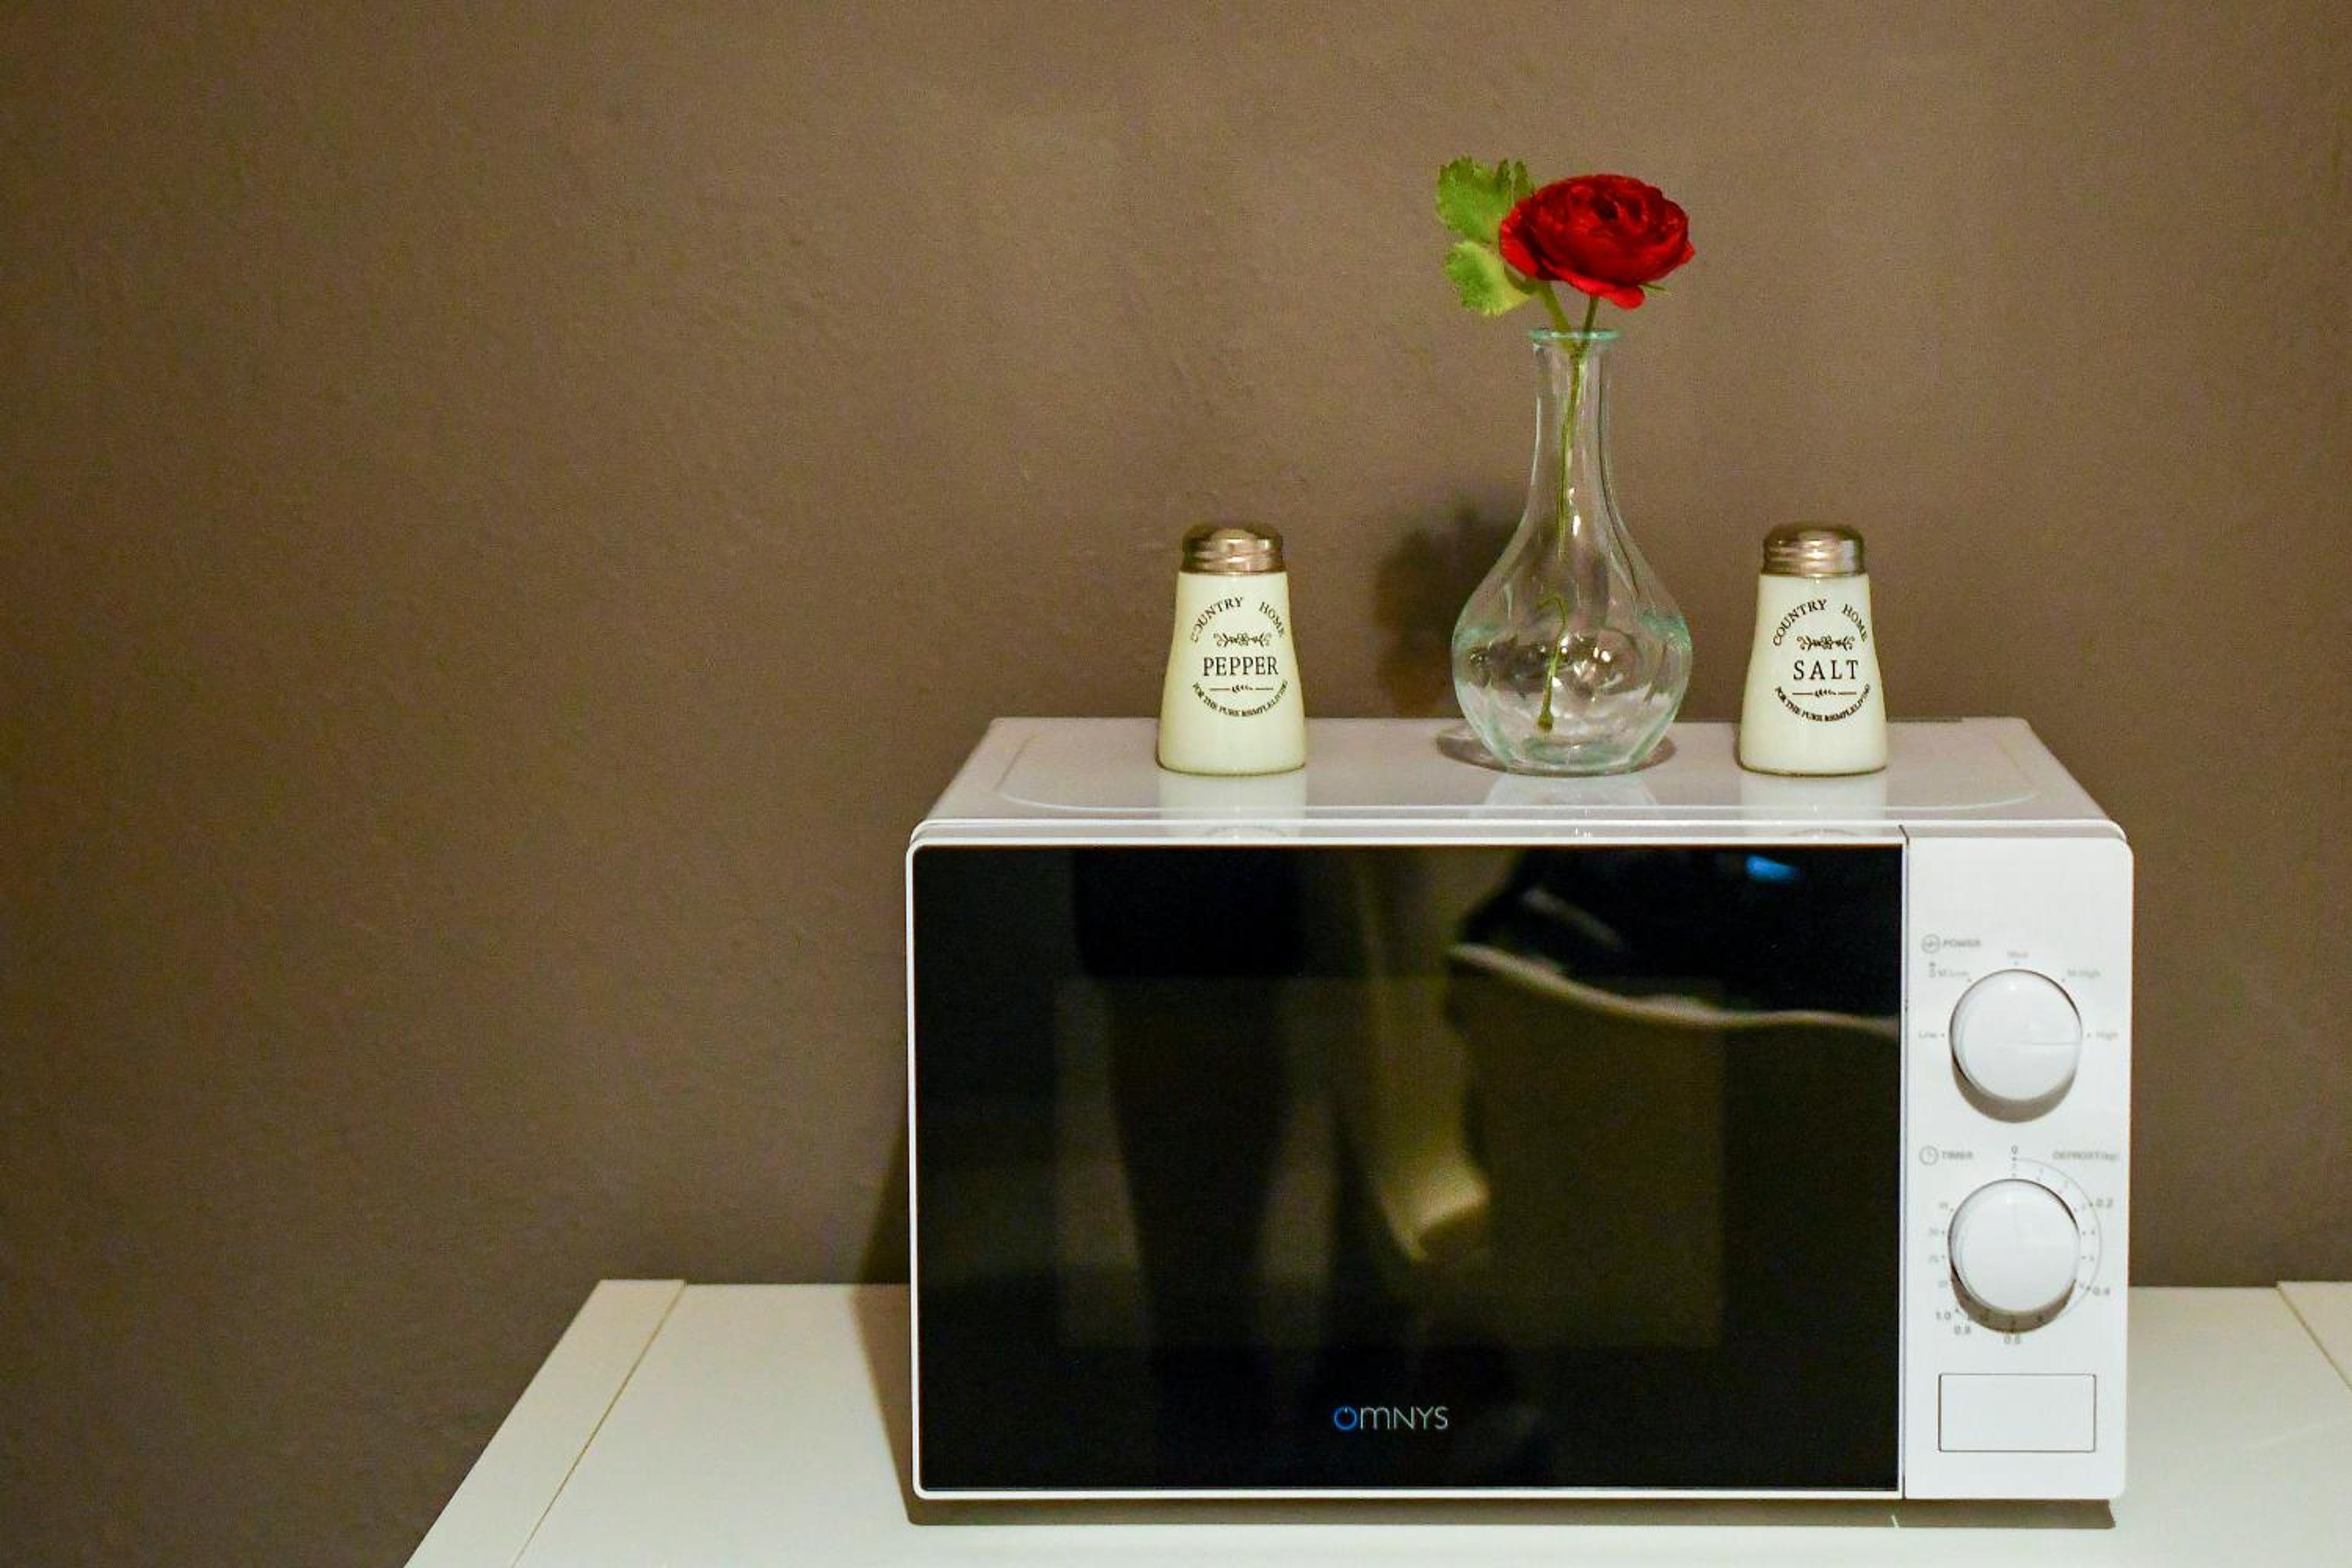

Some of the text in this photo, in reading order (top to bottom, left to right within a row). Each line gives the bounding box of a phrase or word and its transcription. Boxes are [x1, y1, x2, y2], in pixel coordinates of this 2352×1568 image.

[1190, 597, 1285, 643] COUNTRY HOME
[1773, 599, 1867, 646] COUNTRY HOME
[1203, 656, 1279, 677] PEPPER
[1793, 659, 1859, 681] SALT
